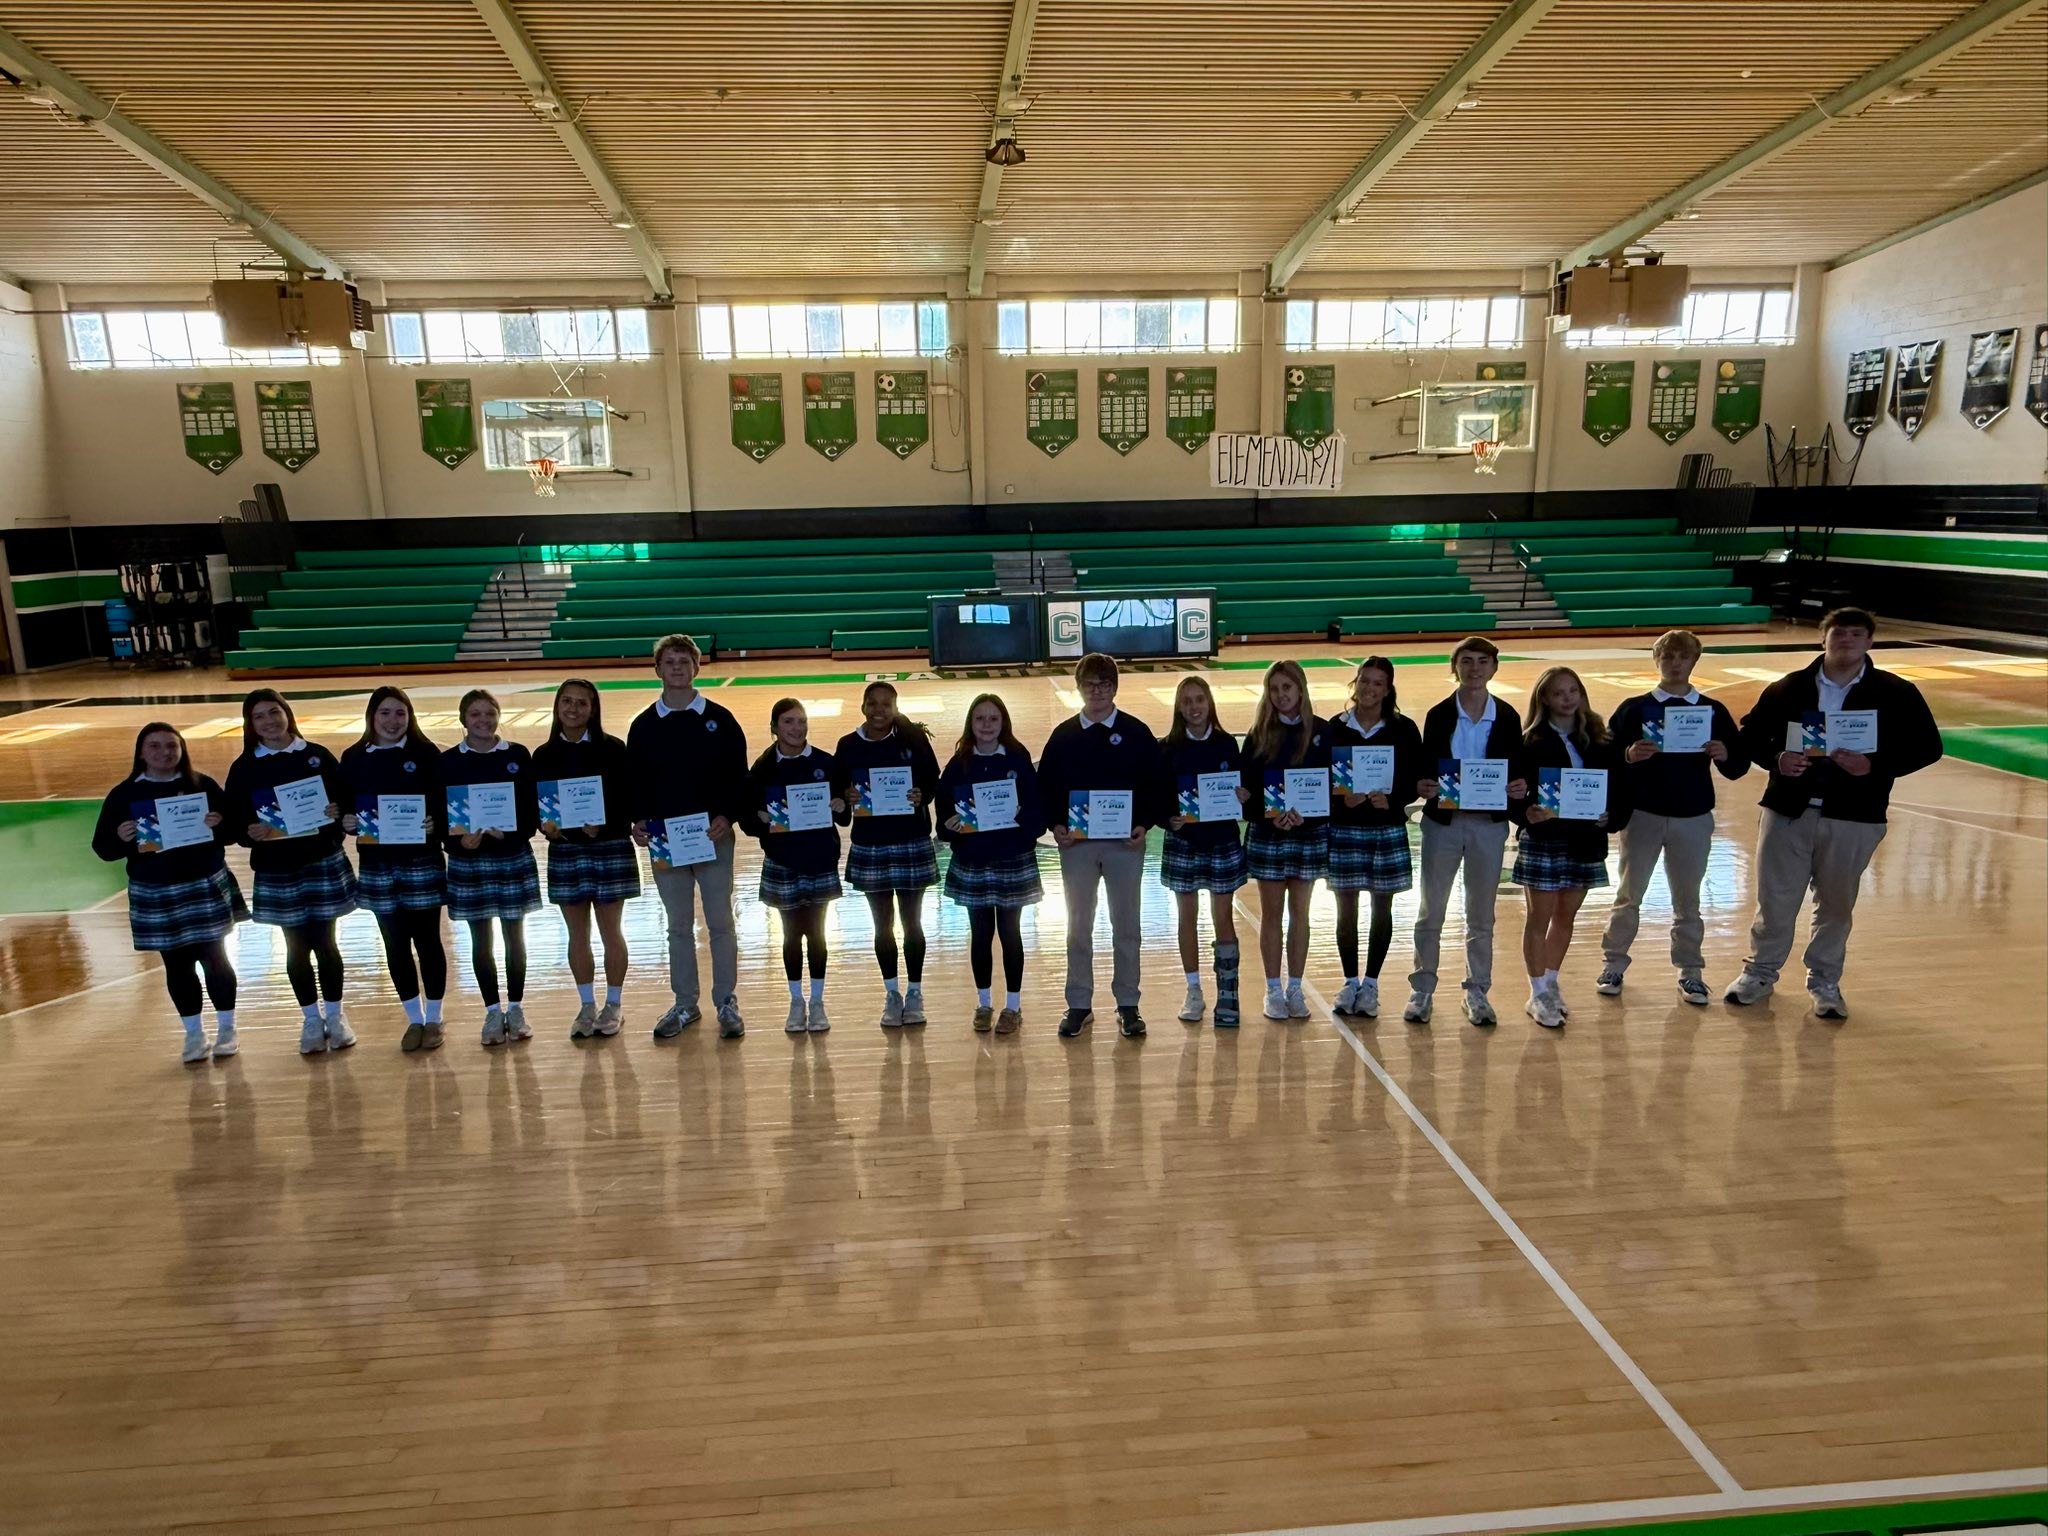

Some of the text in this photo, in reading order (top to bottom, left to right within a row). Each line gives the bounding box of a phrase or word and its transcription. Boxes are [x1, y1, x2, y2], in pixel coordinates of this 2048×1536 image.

[1906, 417, 1917, 433] C
[1975, 415, 1988, 427] C
[1600, 433, 1612, 442] C
[1665, 431, 1677, 442] C
[1729, 430, 1740, 440] C
[1046, 443, 1058, 453] C
[1117, 441, 1130, 452] C
[1186, 440, 1196, 450] C
[1303, 437, 1316, 448] C
[752, 448, 765, 459] C
[825, 446, 838, 457] C
[896, 445, 909, 456] C
[209, 460, 222, 470] C
[286, 458, 299, 468] C
[444, 455, 458, 465] C
[1050, 611, 1081, 646] C
[1178, 608, 1208, 642] C
